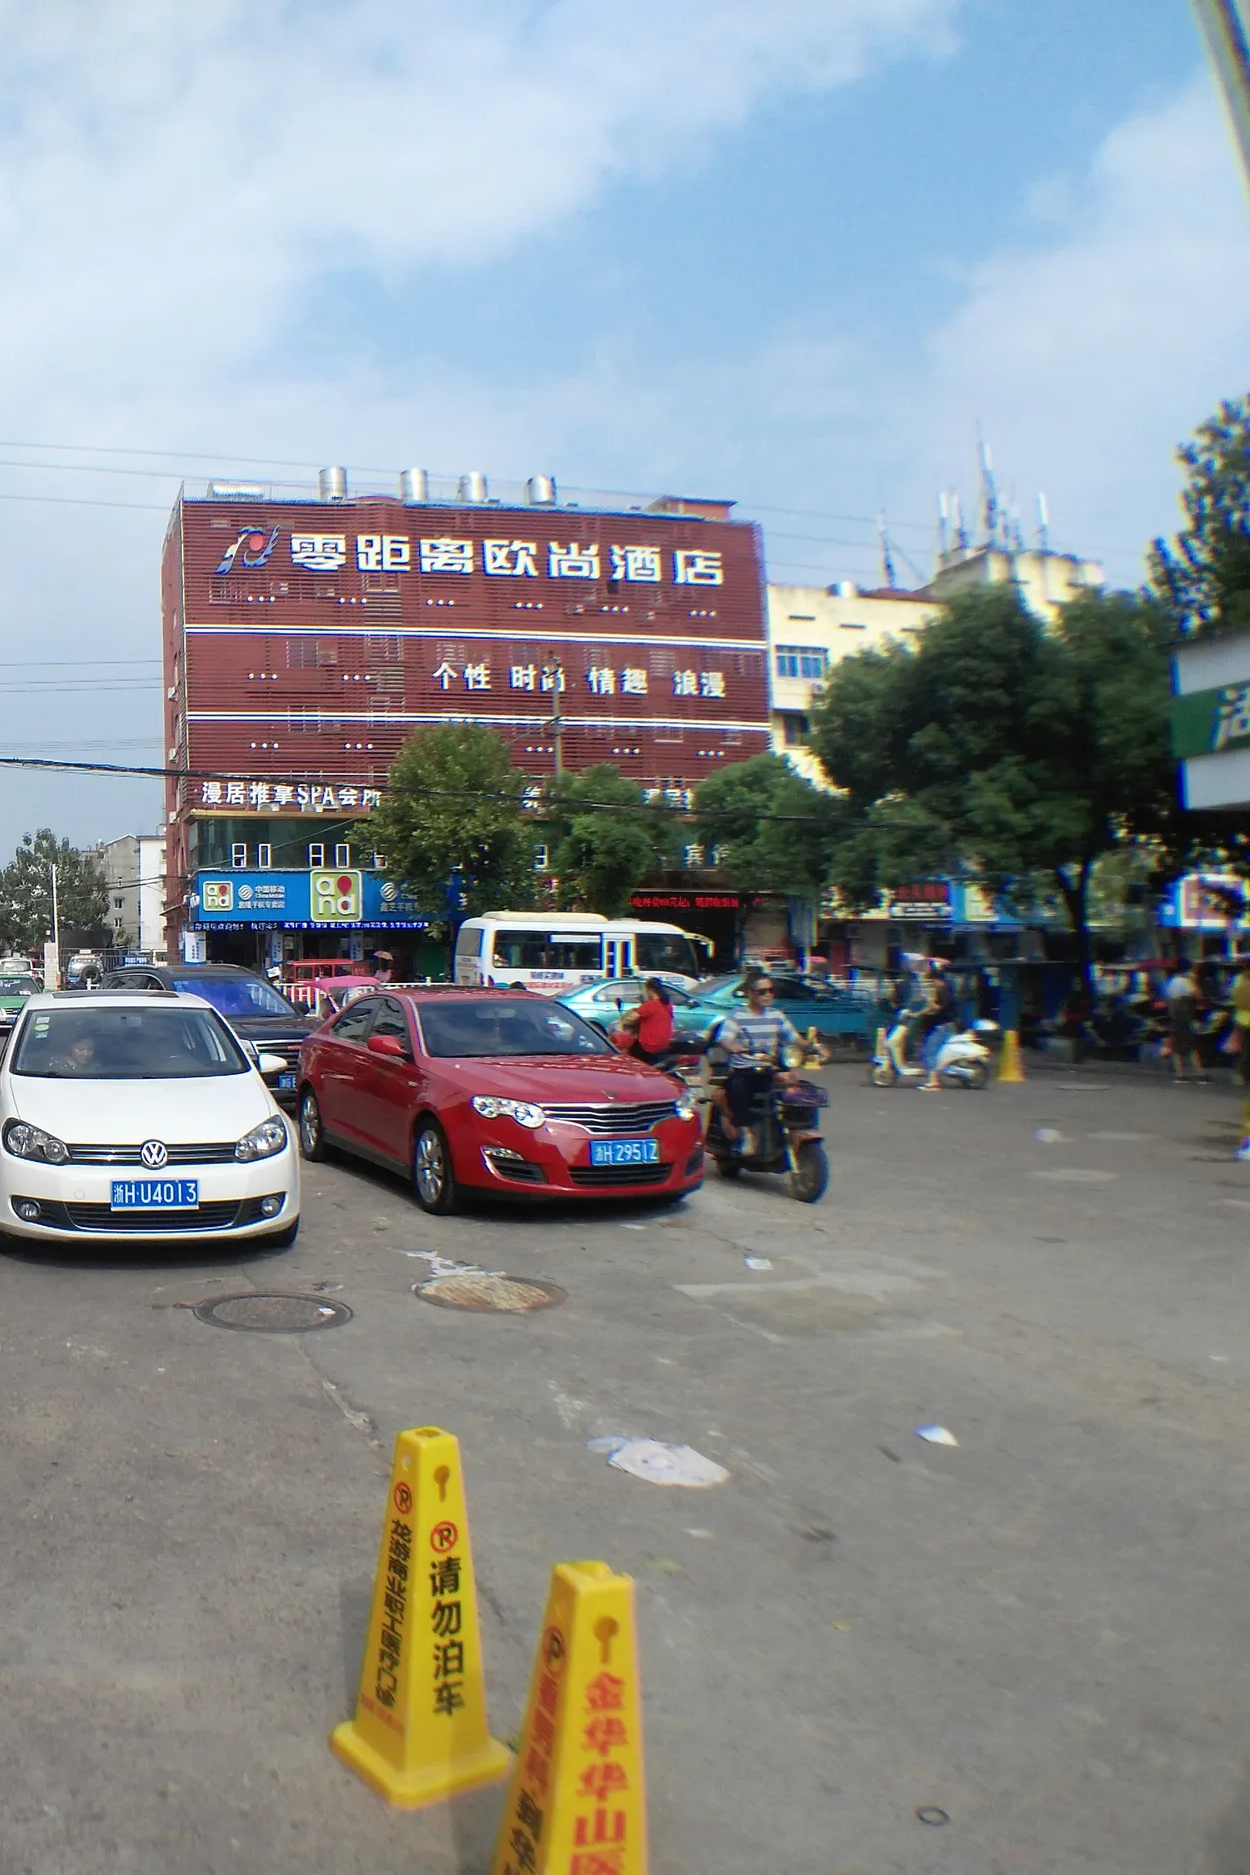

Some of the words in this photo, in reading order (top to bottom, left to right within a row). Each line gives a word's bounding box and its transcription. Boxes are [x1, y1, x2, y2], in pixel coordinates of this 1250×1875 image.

[290, 532, 725, 587] 零距离欧尚酒店
[433, 663, 493, 692] 个性
[510, 664, 566, 693] 时尚
[588, 666, 648, 696] 情趣
[672, 670, 727, 698] 浪漫
[429, 1556, 466, 1717] 请勿泊车
